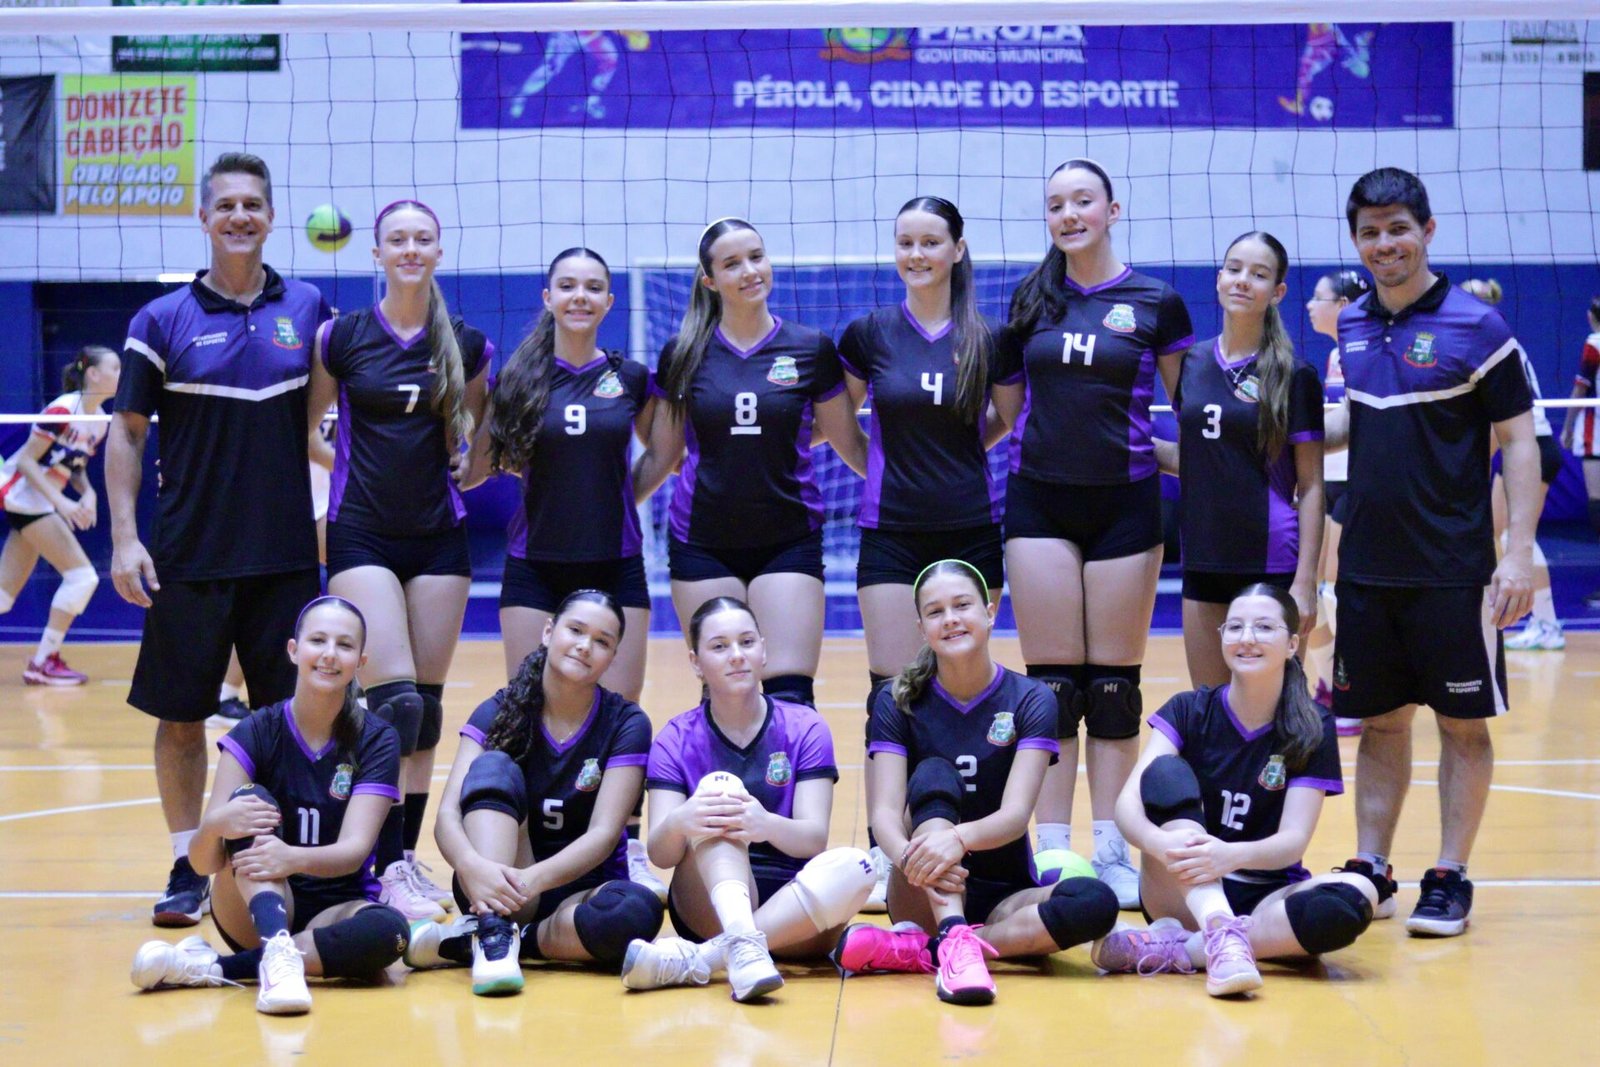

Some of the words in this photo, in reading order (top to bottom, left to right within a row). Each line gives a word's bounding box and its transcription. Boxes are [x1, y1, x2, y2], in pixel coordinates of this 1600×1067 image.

[915, 48, 995, 64] GOVERNO
[1001, 48, 1085, 64] MUNICIPAL
[66, 85, 187, 122] DONIZETE
[733, 74, 863, 113] PÉROLA,
[870, 80, 984, 108] CIDADE
[989, 80, 1034, 108] DO
[1042, 80, 1180, 108] ESPORTE
[72, 163, 178, 184] OBRIGADO
[66, 185, 117, 206] PELO
[119, 185, 185, 206] APOIO
[1062, 332, 1096, 366] 14
[398, 384, 420, 413] 7
[921, 372, 943, 405] 4
[564, 405, 586, 435] 9
[735, 392, 757, 425] 8
[1202, 404, 1222, 439] 3
[956, 755, 978, 792] 2
[298, 807, 320, 845] 11
[543, 798, 564, 830] 5
[1221, 789, 1251, 831] 12
